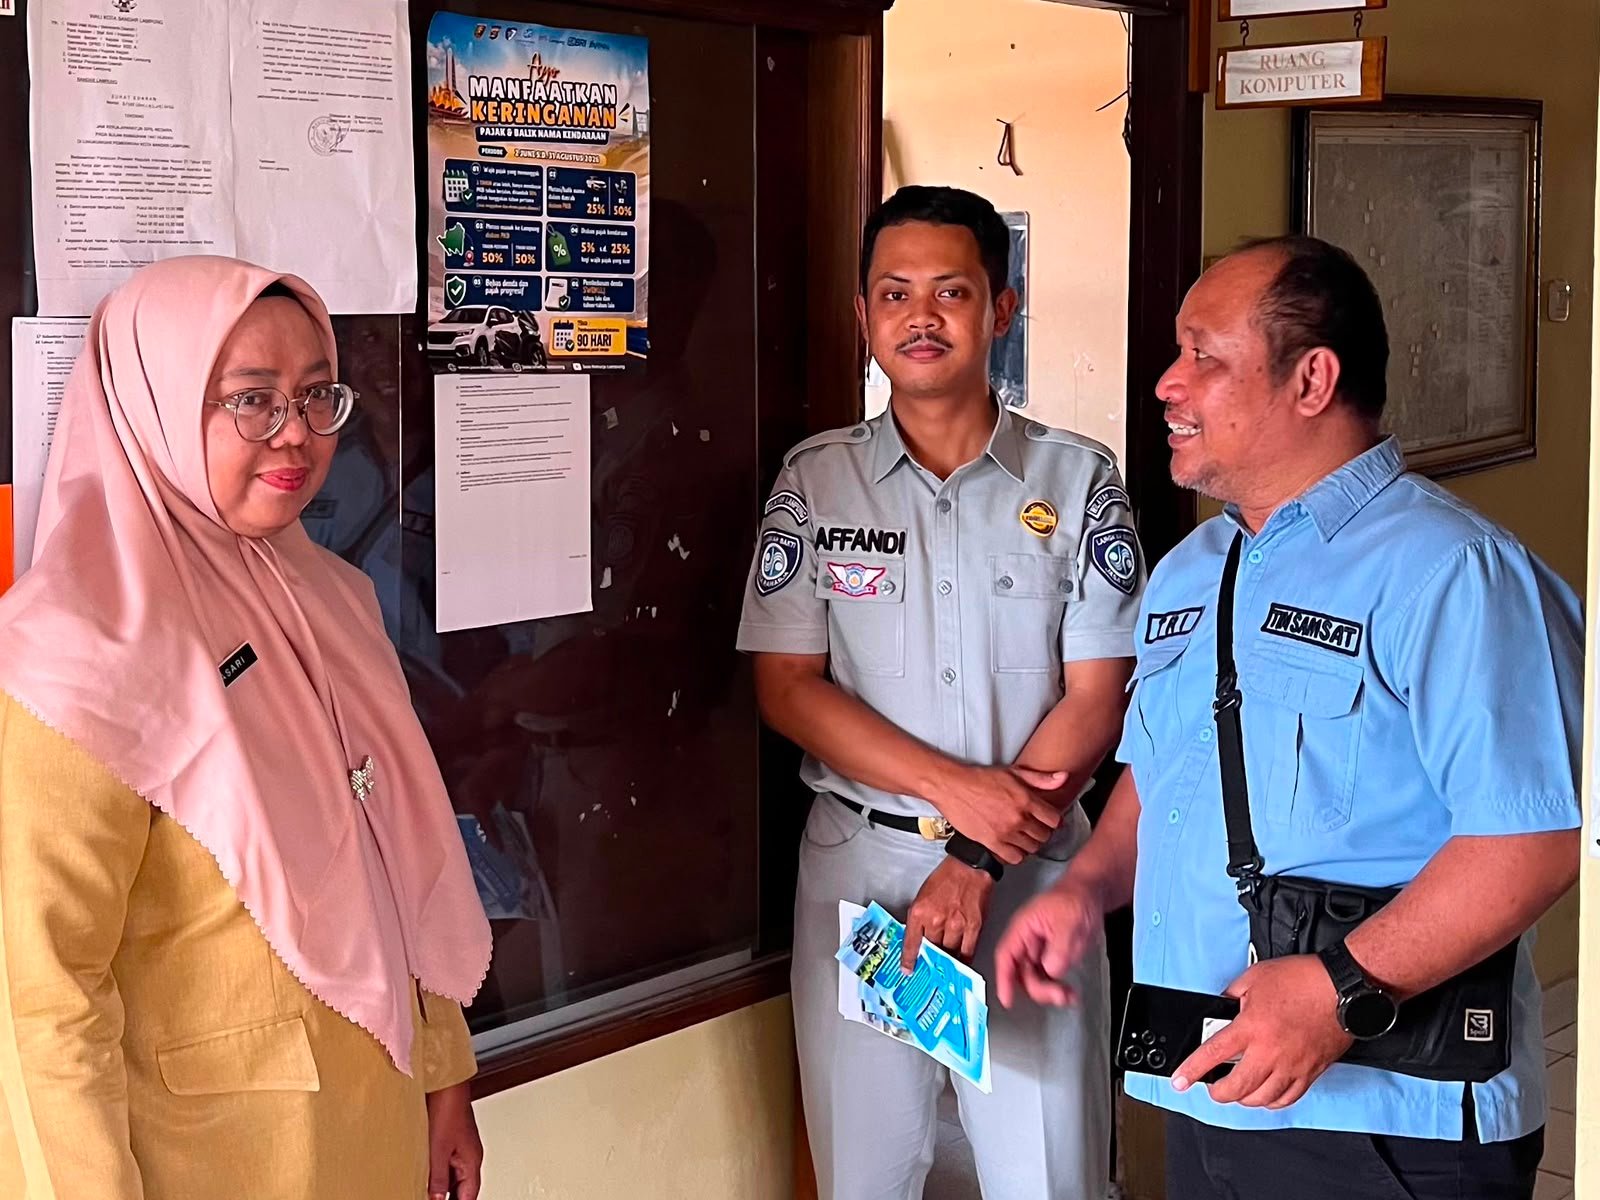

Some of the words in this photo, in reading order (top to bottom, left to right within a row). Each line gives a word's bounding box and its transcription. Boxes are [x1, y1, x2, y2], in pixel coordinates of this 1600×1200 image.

[527, 51, 560, 86] Ayo
[1259, 51, 1326, 70] RUANG
[469, 76, 617, 105] MANFAATKAN
[1239, 73, 1346, 95] KOMPUTER
[471, 100, 617, 128] KERINGANAN
[480, 127, 506, 137] PAJAK
[506, 129, 512, 137] &
[513, 130, 538, 138] BALIK
[538, 130, 562, 139] NAMA
[562, 132, 606, 141] KENDARAAN
[481, 147, 504, 156] PERIODE
[514, 148, 520, 157] 2
[556, 152, 584, 162] AGUSTUS
[584, 154, 600, 164] 2026
[586, 204, 606, 214] 25%
[614, 206, 632, 216] 50%
[520, 226, 540, 234] Lampung
[580, 242, 596, 253] 5%
[610, 244, 630, 254] 25%
[482, 252, 504, 264] 50%
[515, 253, 536, 264] 50%
[484, 287, 499, 296] pajak
[500, 288, 524, 296] progresif
[485, 278, 502, 288] Bebas
[577, 334, 588, 346] 90
[590, 334, 612, 347] HARI
[815, 526, 906, 555] AFFANDI
[1270, 610, 1292, 631] TIM
[1290, 612, 1357, 648] SAMSAT
[222, 656, 246, 680] SARI
